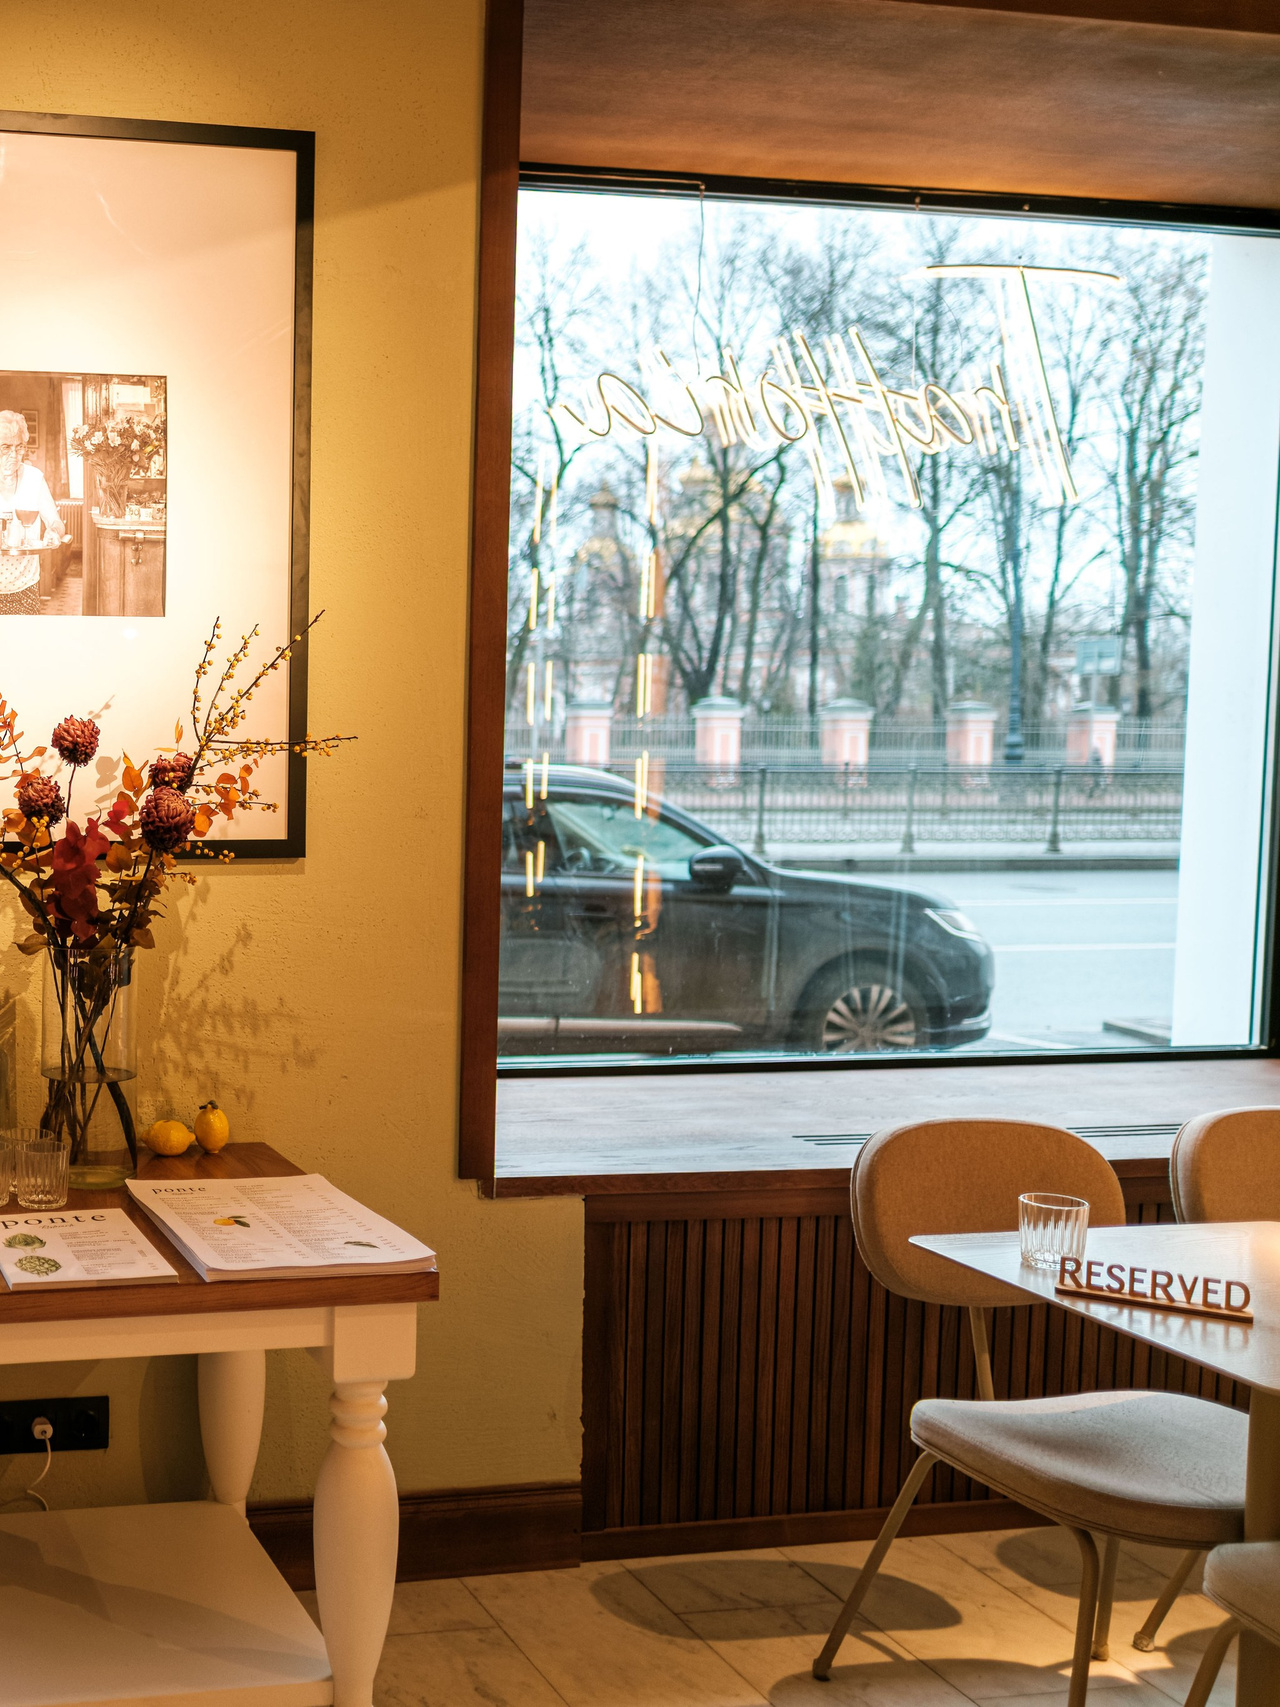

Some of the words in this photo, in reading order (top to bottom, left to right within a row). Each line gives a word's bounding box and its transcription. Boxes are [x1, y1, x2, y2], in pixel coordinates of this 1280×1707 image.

[151, 1186, 207, 1195] ponte
[0, 1214, 107, 1230] ponte
[1058, 1256, 1251, 1311] RESERVED
